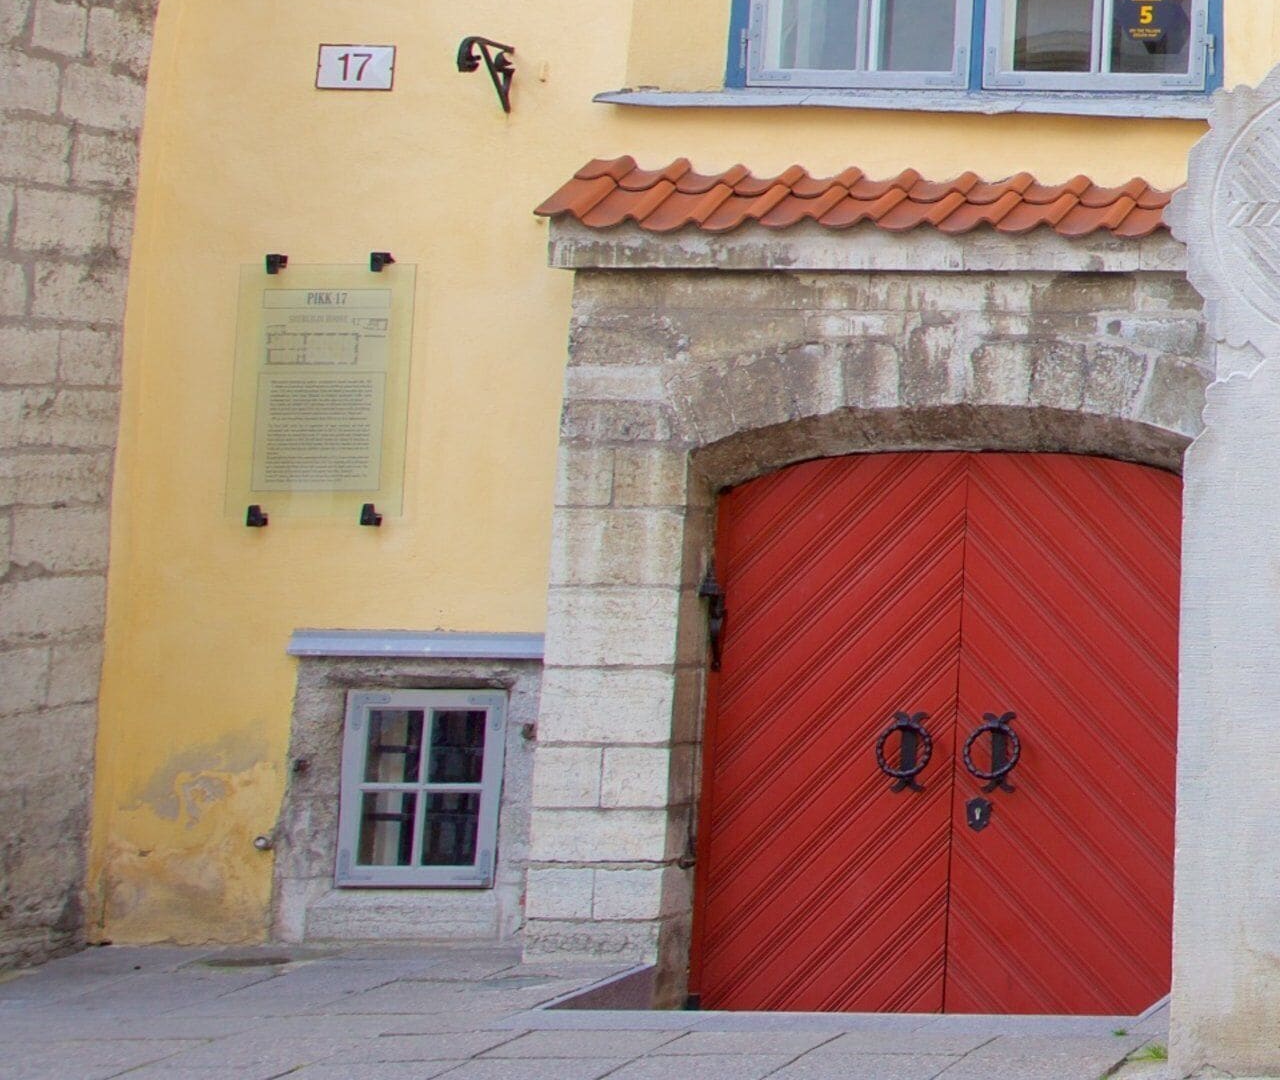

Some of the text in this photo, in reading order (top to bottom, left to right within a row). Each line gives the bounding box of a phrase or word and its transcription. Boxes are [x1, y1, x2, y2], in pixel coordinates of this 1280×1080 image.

[1140, 5, 1153, 24] 5
[338, 53, 373, 81] 17
[307, 291, 348, 305] PIKK 17
